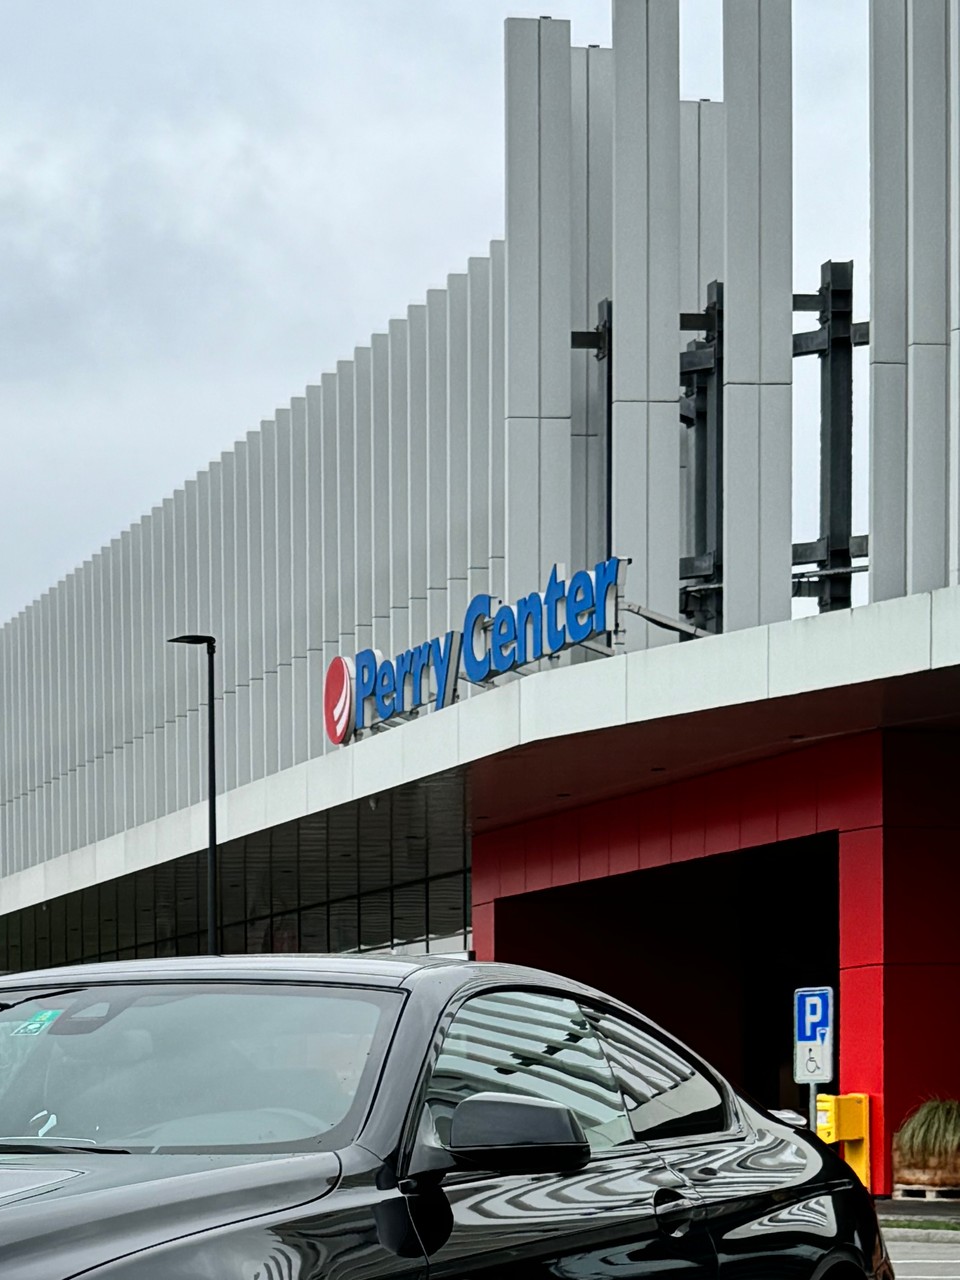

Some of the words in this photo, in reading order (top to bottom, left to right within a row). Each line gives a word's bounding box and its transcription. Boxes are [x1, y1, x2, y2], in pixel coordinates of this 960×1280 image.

[355, 631, 456, 729] Perry
[463, 557, 618, 682] Center
[805, 996, 822, 1037] P
